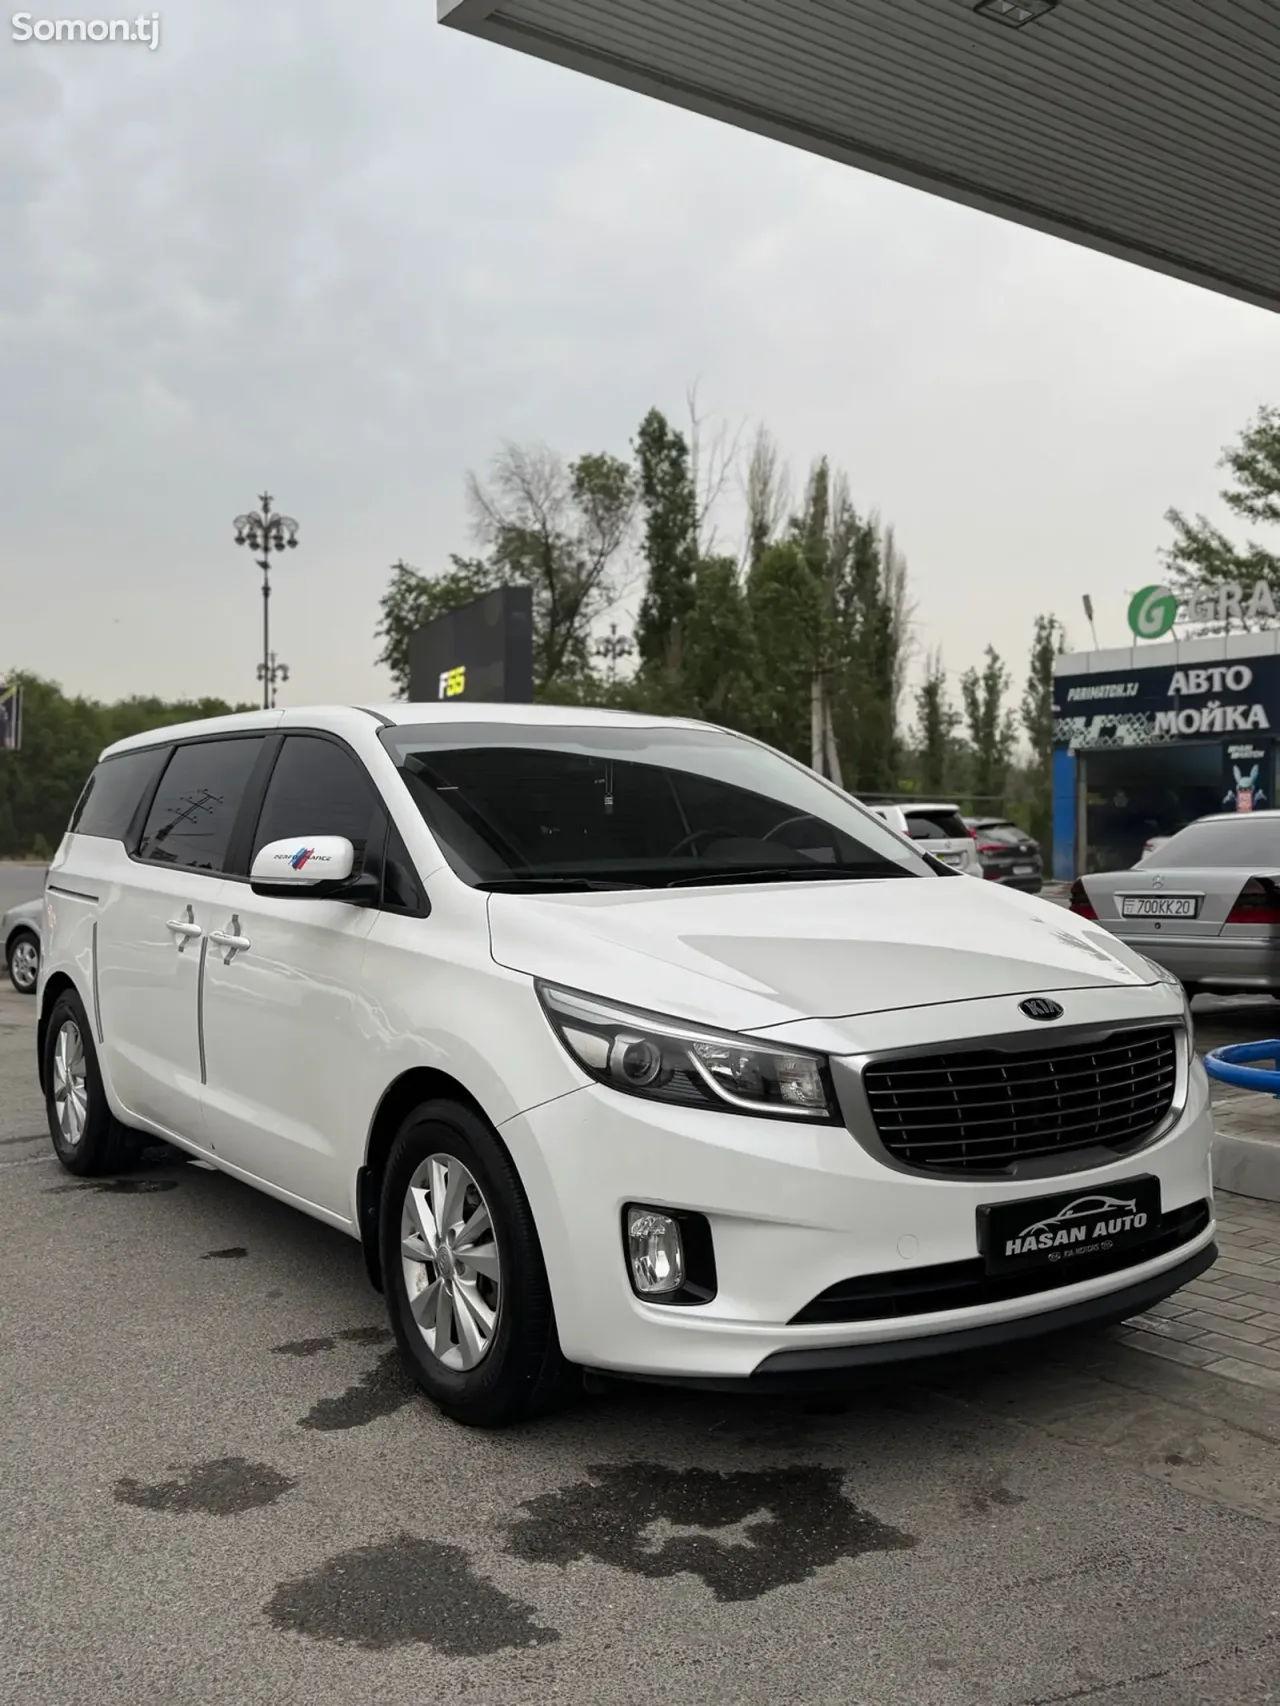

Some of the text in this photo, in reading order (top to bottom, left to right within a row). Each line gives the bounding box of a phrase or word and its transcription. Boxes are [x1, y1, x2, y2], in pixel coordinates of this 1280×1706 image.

[1188, 580, 1277, 622] GRA
[1167, 665, 1252, 696] АВТО
[1152, 700, 1270, 736] МОЙКА
[1023, 1000, 1061, 1015] KIA
[1005, 1212, 1148, 1256] HASAN AUTO
